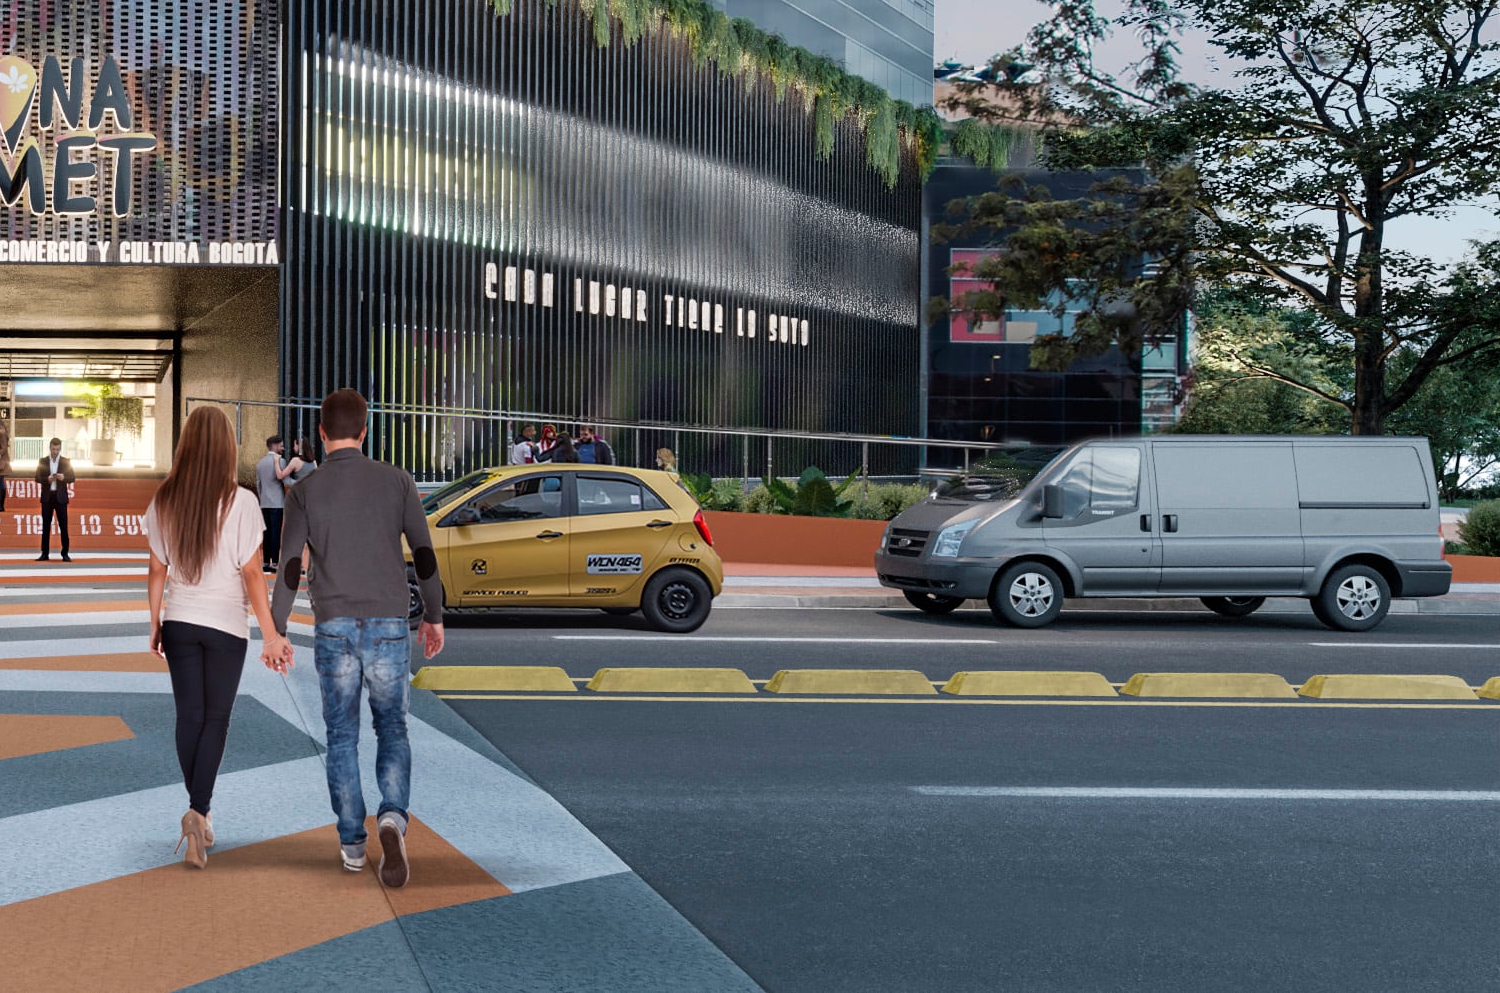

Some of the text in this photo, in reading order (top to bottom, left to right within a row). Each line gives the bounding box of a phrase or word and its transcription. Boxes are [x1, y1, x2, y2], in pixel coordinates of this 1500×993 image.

[97, 241, 111, 263] Y
[119, 241, 200, 264] CULTURA
[208, 239, 279, 265] BOGOTÁ
[485, 262, 554, 308] CADA
[575, 278, 647, 322] LUGAR
[737, 307, 756, 339] LO
[80, 514, 102, 536] LO
